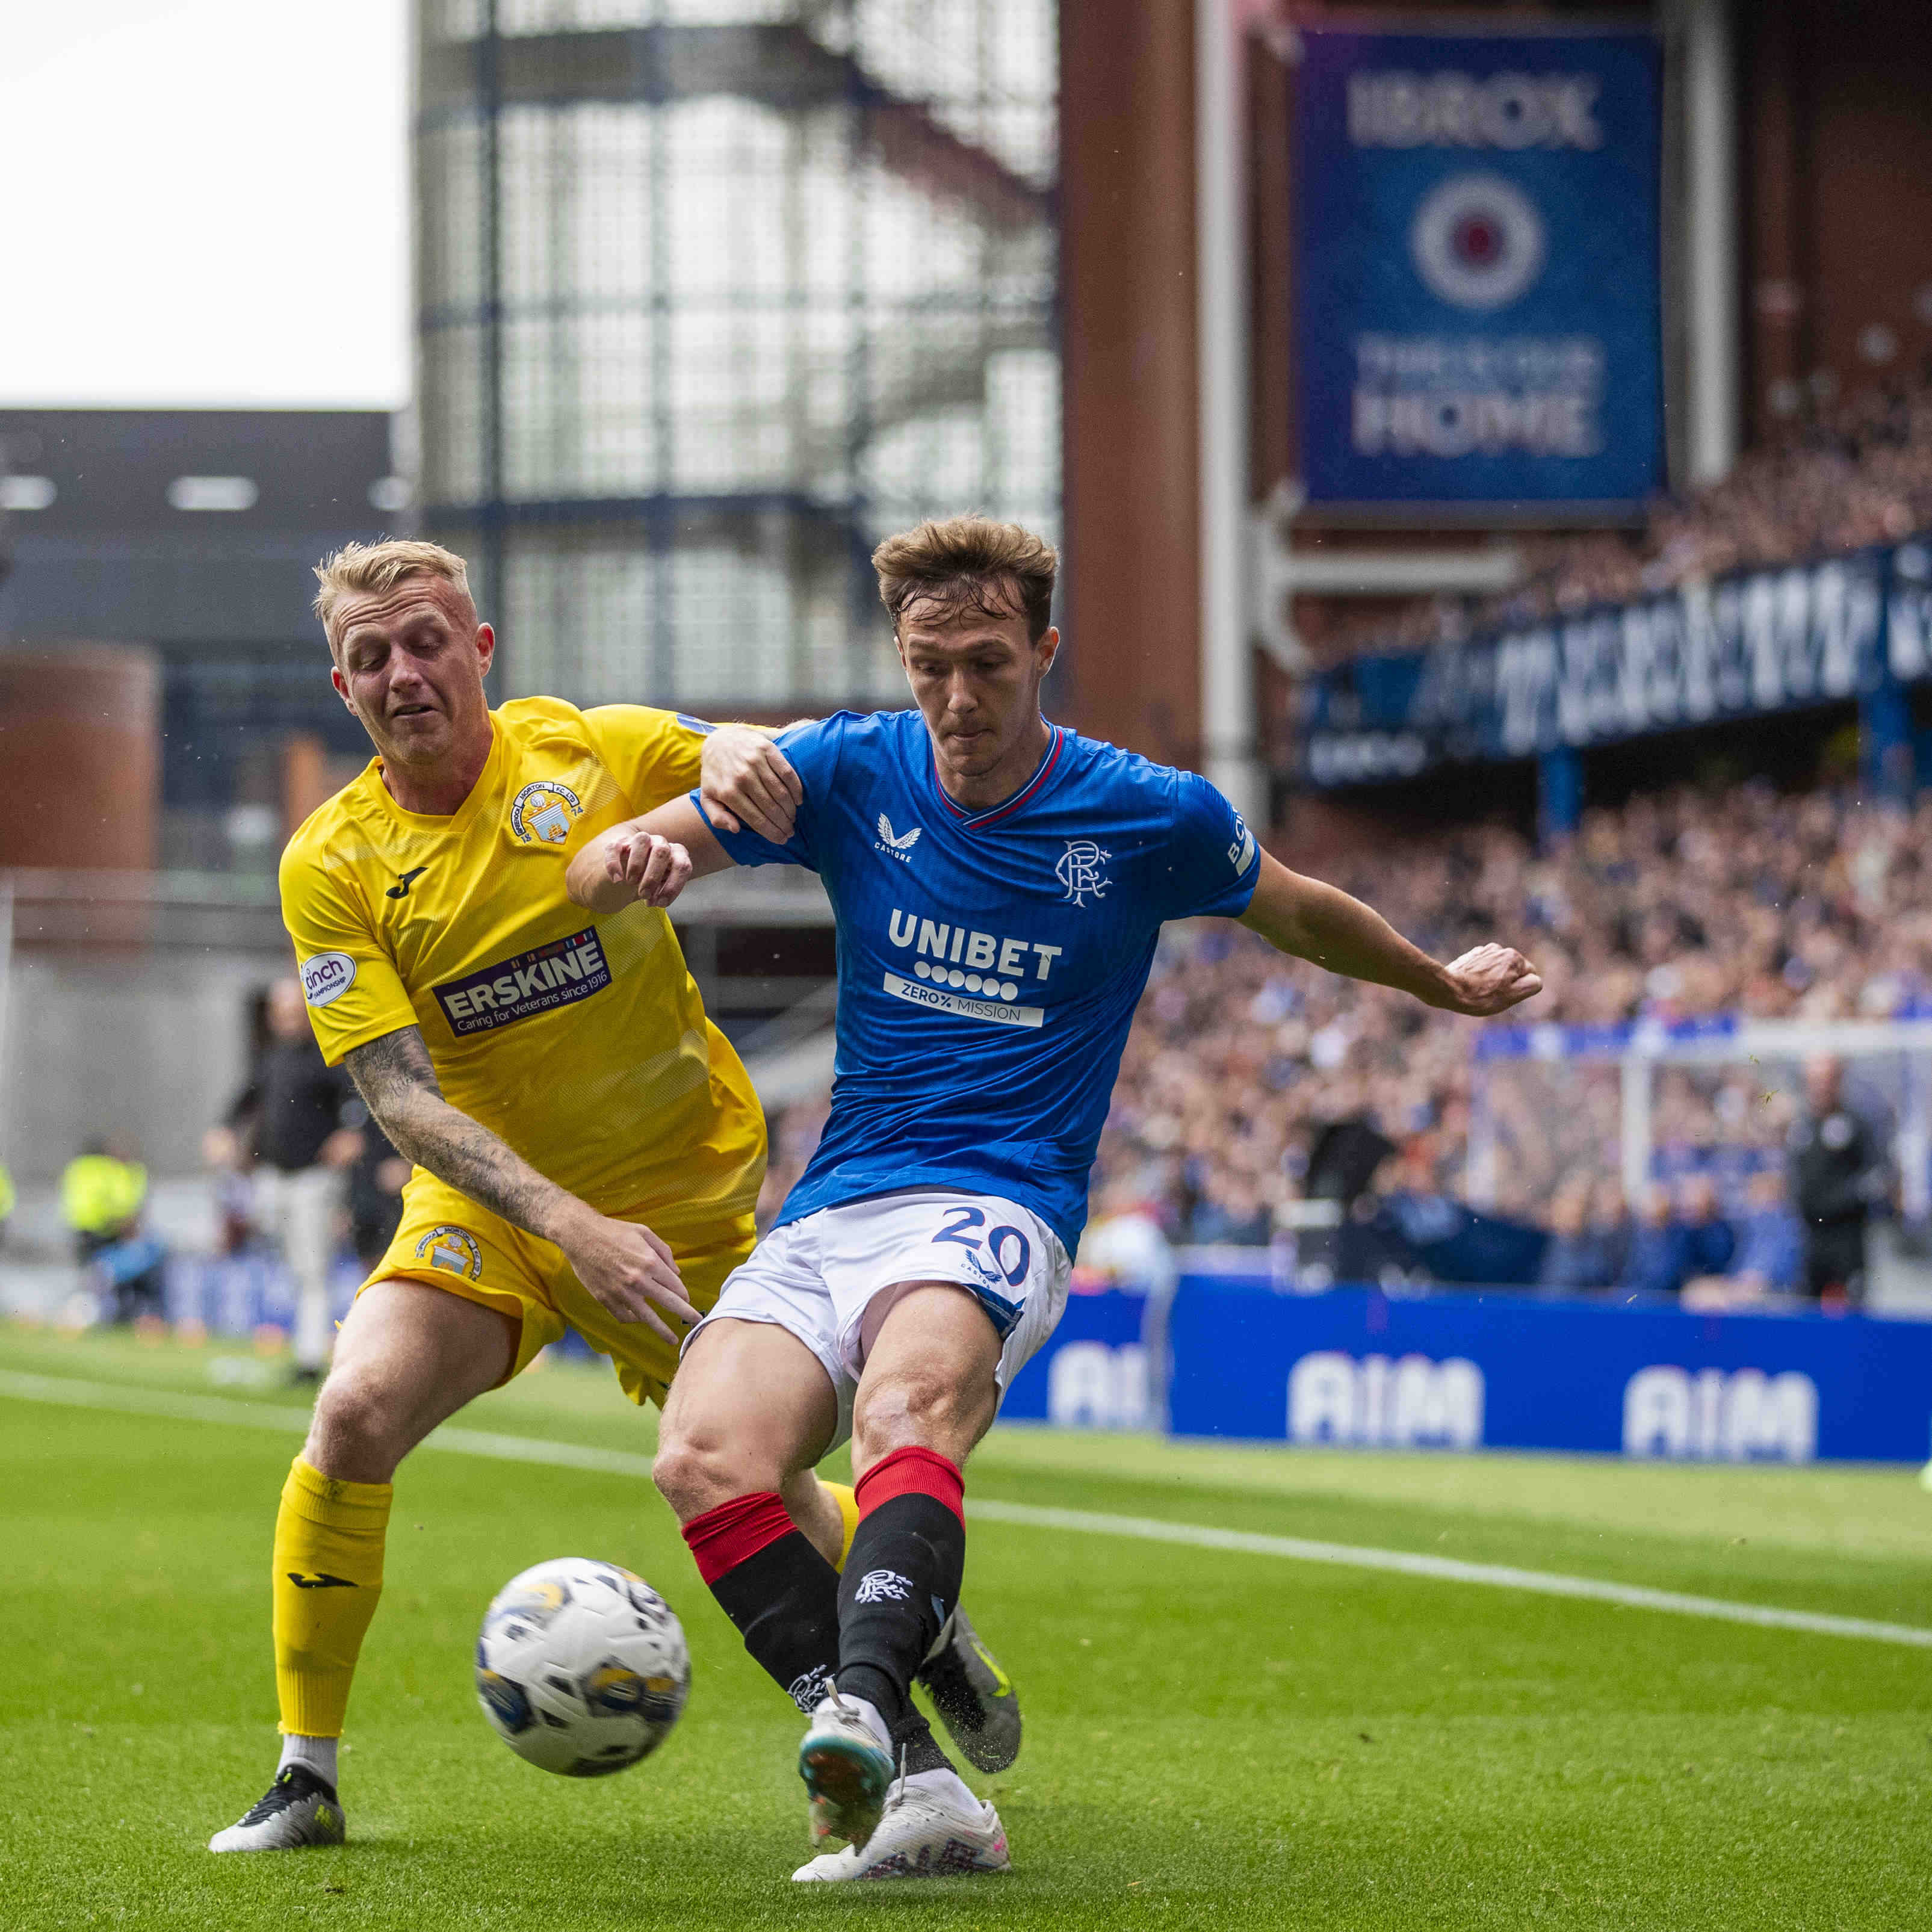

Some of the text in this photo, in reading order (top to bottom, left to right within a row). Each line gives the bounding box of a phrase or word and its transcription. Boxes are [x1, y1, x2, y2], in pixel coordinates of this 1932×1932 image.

[1349, 71, 1602, 149] IBROX
[1353, 388, 1602, 456] HOME
[521, 833, 531, 844] 18
[571, 806, 583, 816] 74
[875, 842, 912, 862] CASTORE
[306, 960, 344, 990] cinch
[888, 908, 1062, 980] UNIBET
[444, 941, 603, 1019] ERSKINE
[457, 970, 607, 1031] Caring for Veterans since 1916
[902, 982, 1021, 1021] ZERO% MISSION
[930, 1207, 1030, 1287] 20
[1288, 1352, 1484, 1444] AIM
[1623, 1365, 1818, 1463] AIM
